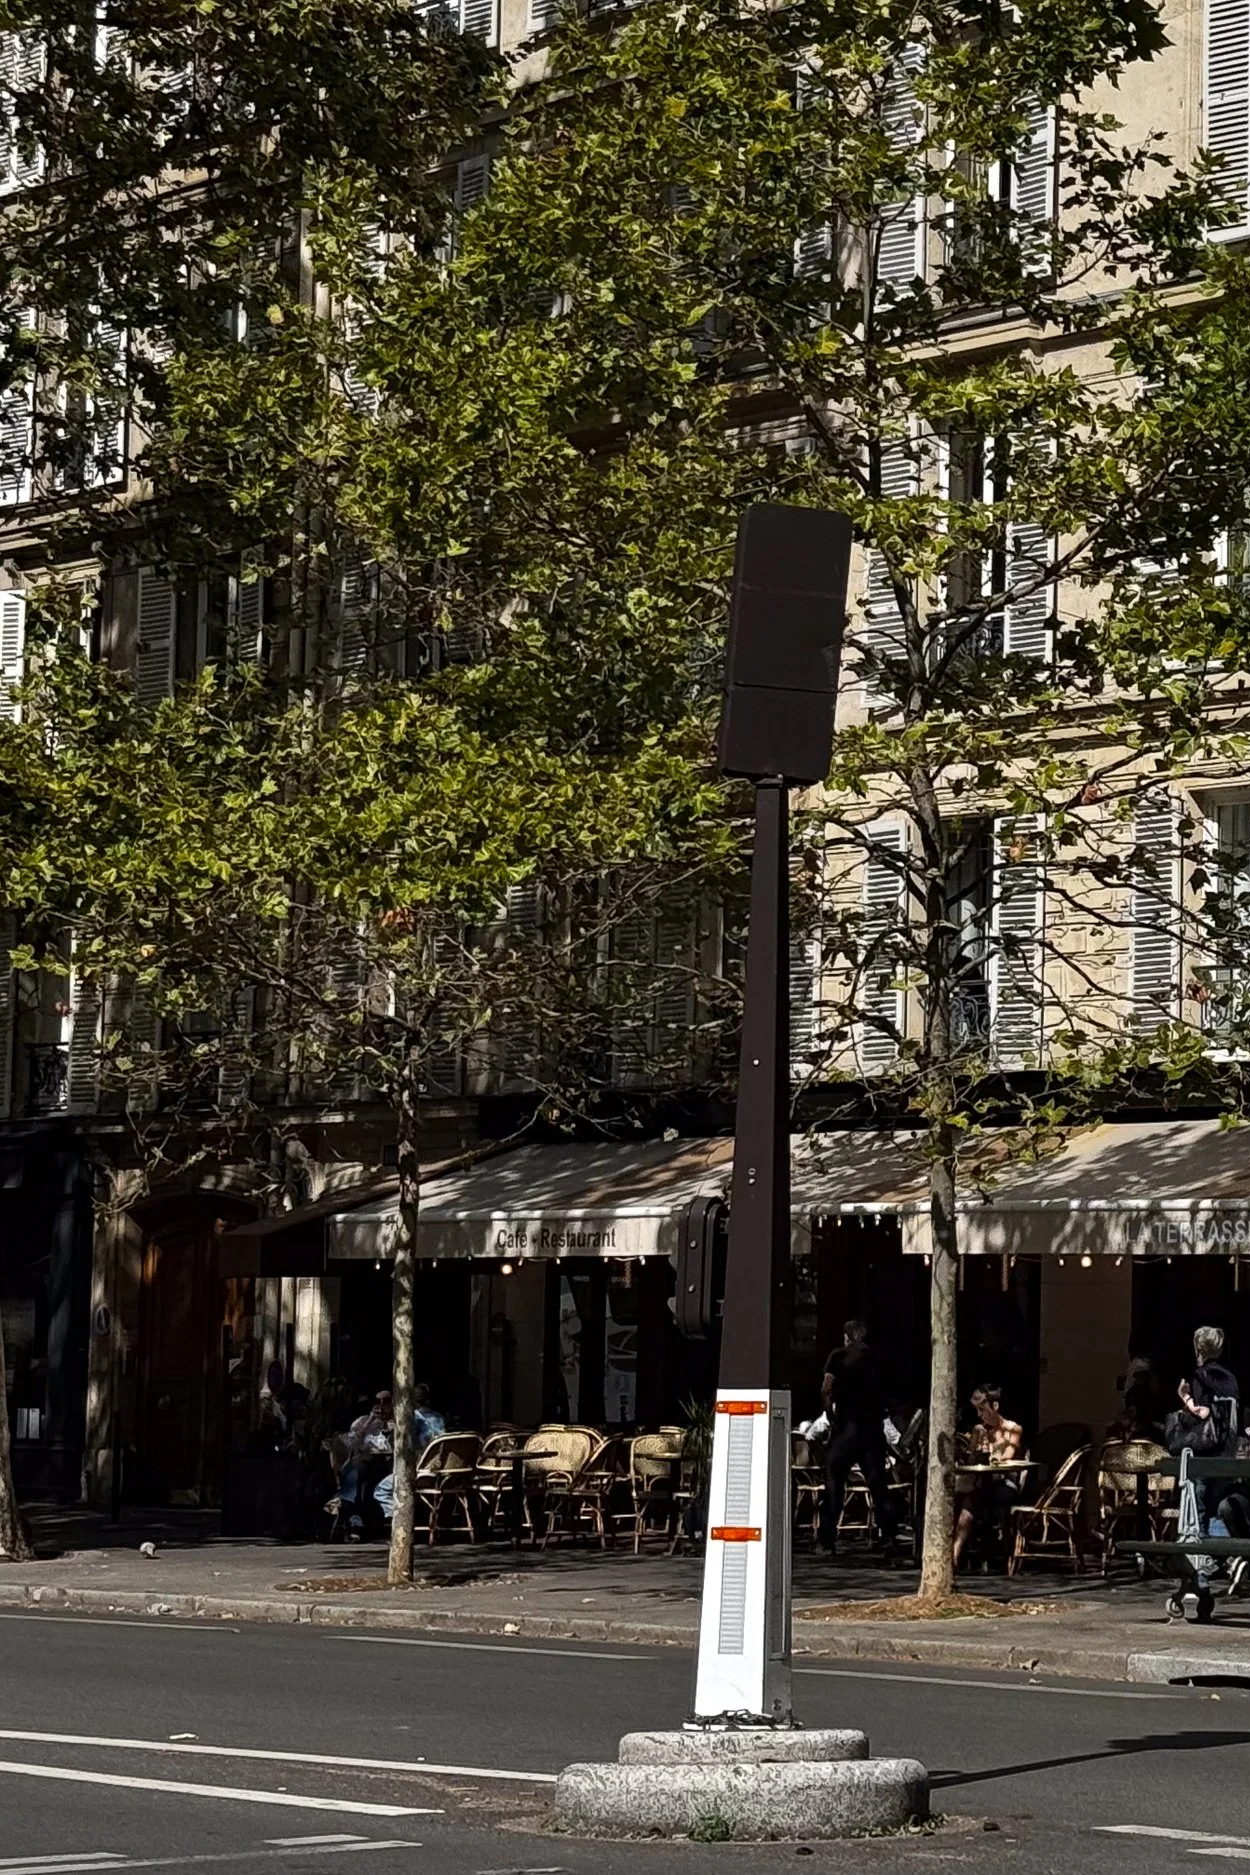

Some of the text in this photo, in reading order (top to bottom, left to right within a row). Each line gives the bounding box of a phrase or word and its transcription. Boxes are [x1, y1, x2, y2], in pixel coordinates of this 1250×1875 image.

[497, 1228, 528, 1248] Café
[541, 1228, 617, 1248] Restaurant
[1125, 1221, 1149, 1243] LA
